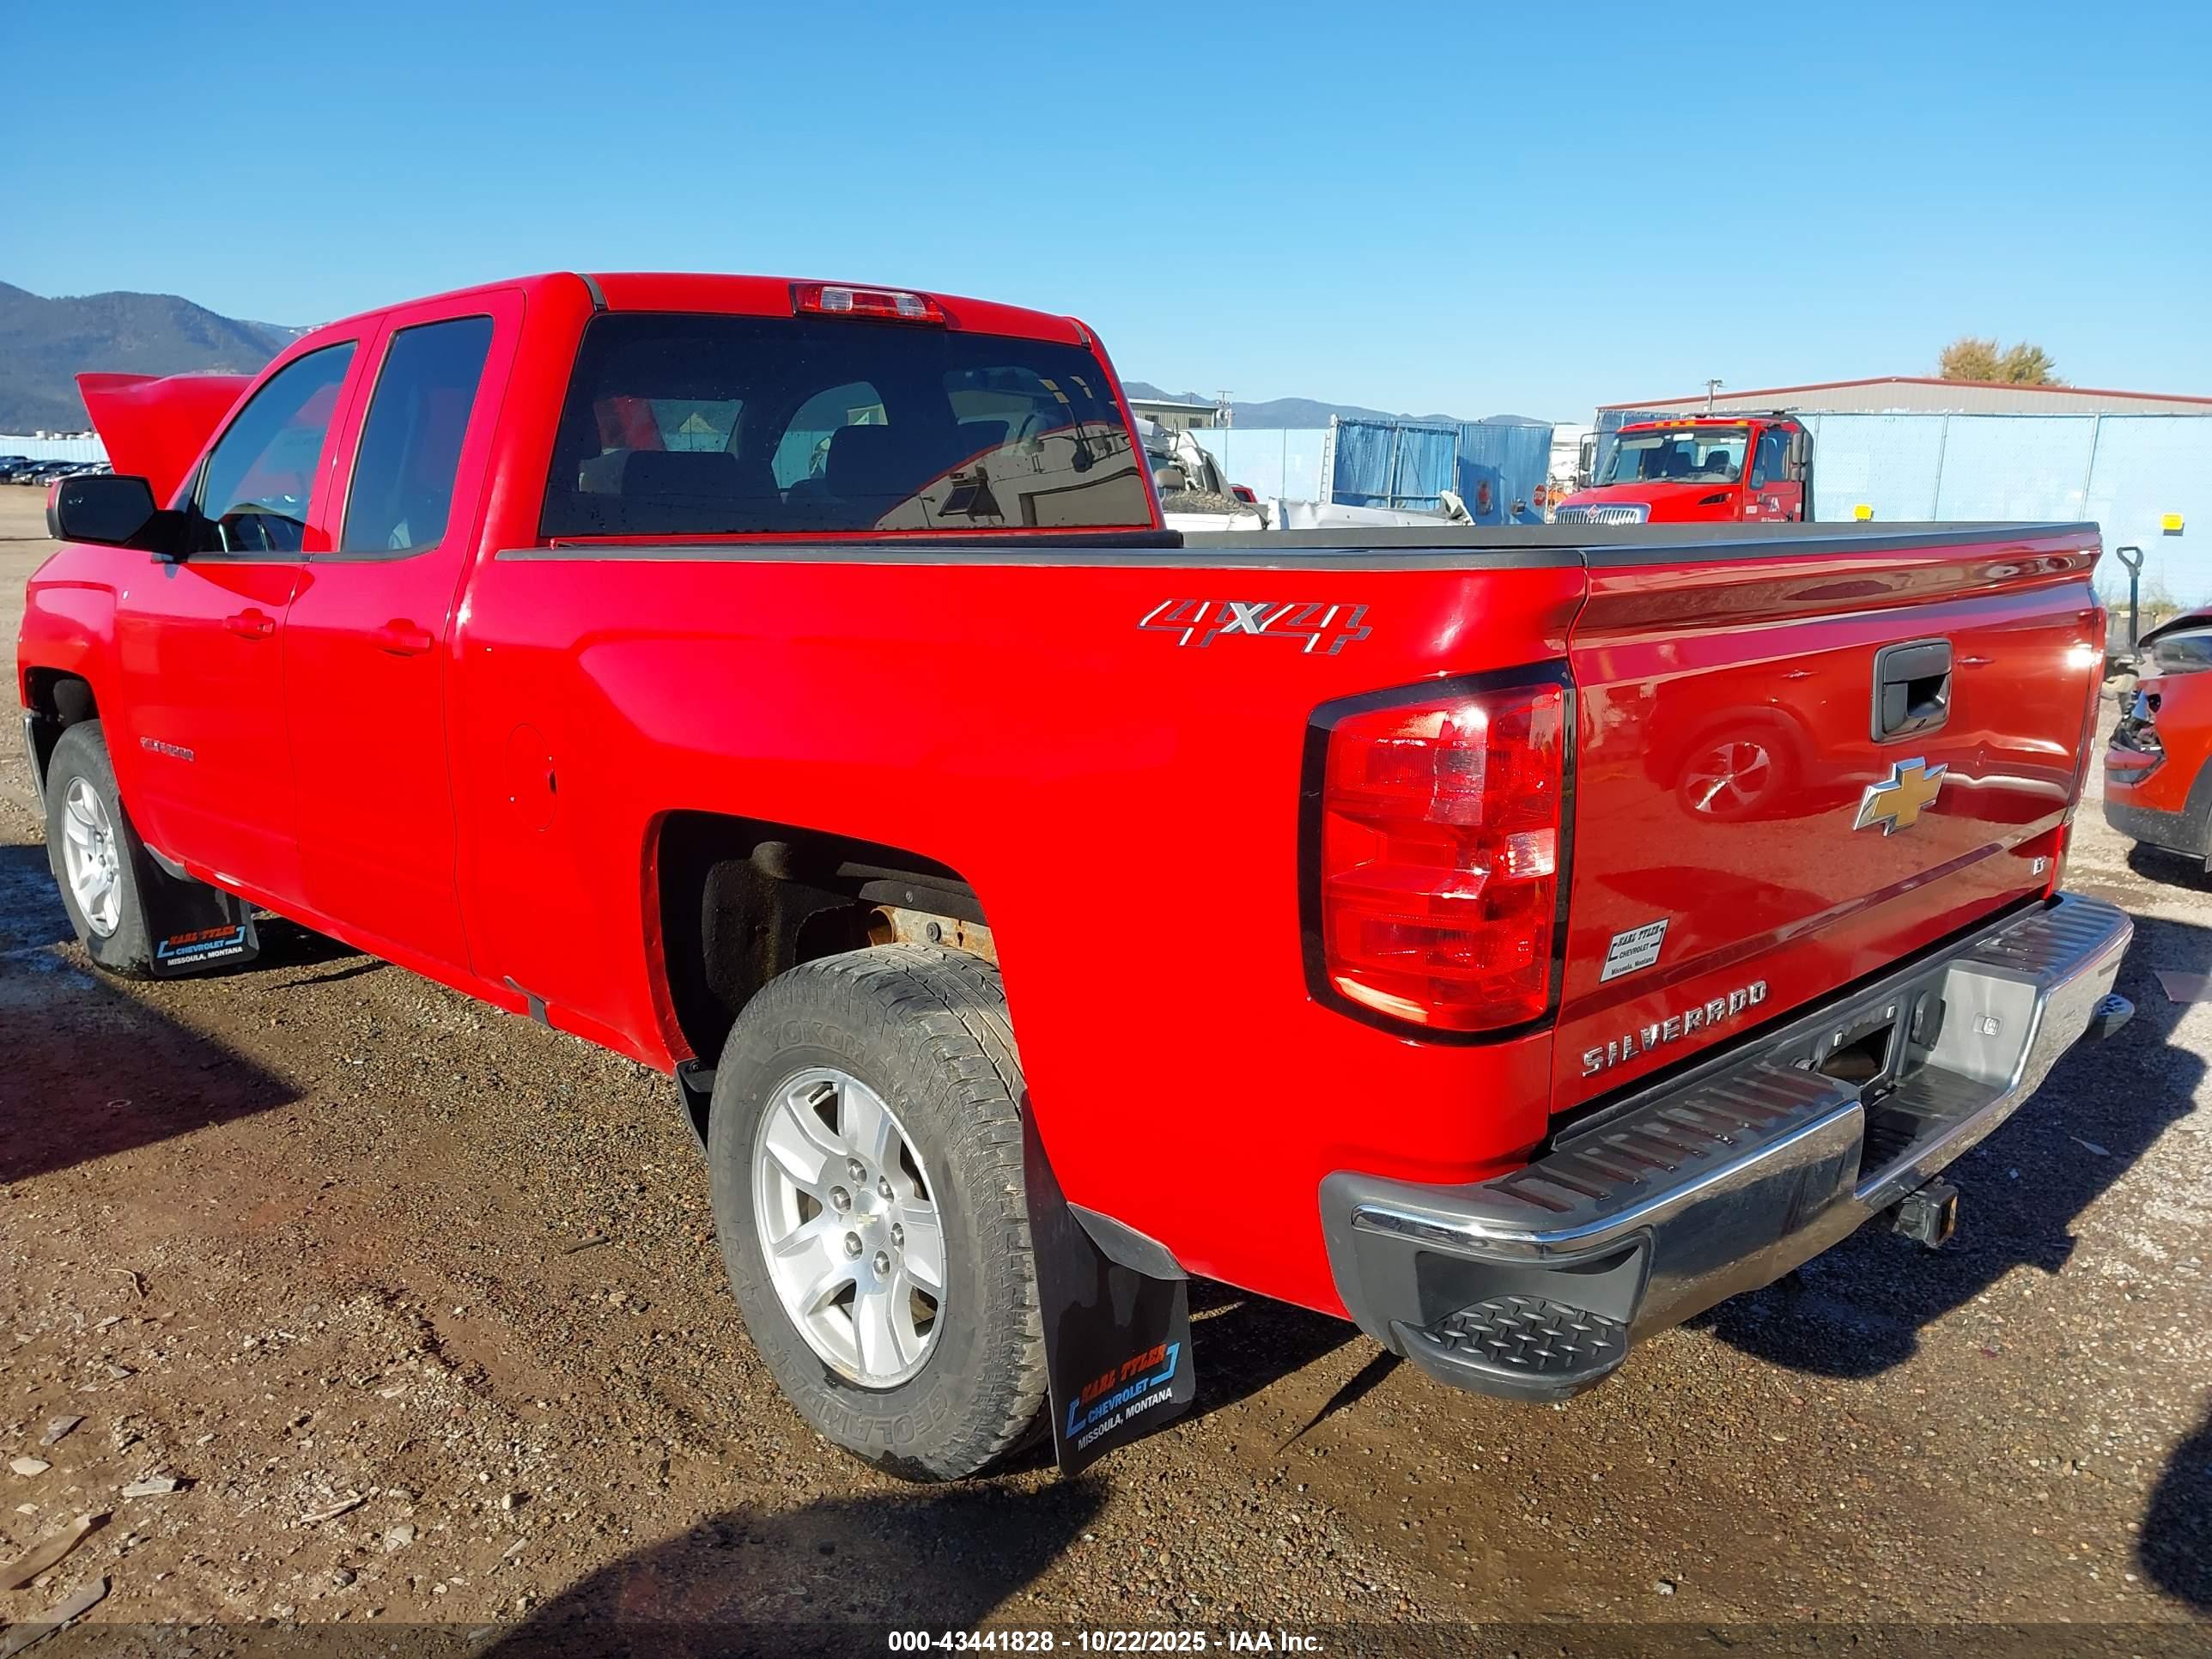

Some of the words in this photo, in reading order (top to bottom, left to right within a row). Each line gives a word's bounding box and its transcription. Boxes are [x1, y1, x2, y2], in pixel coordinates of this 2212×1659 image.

[1638, 925, 1660, 940] TYLER
[176, 940, 224, 955] CHEVROLET
[208, 946, 243, 958] MONTANA
[1619, 943, 1650, 958] CHEVROLET
[1581, 981, 1767, 1077] SILVERADO
[1121, 1343, 1168, 1382] TYLER
[1087, 1378, 1150, 1424] CHEVROLET
[1078, 1413, 1124, 1452] MISSOULA,
[1126, 1388, 1173, 1419] MONTANA
